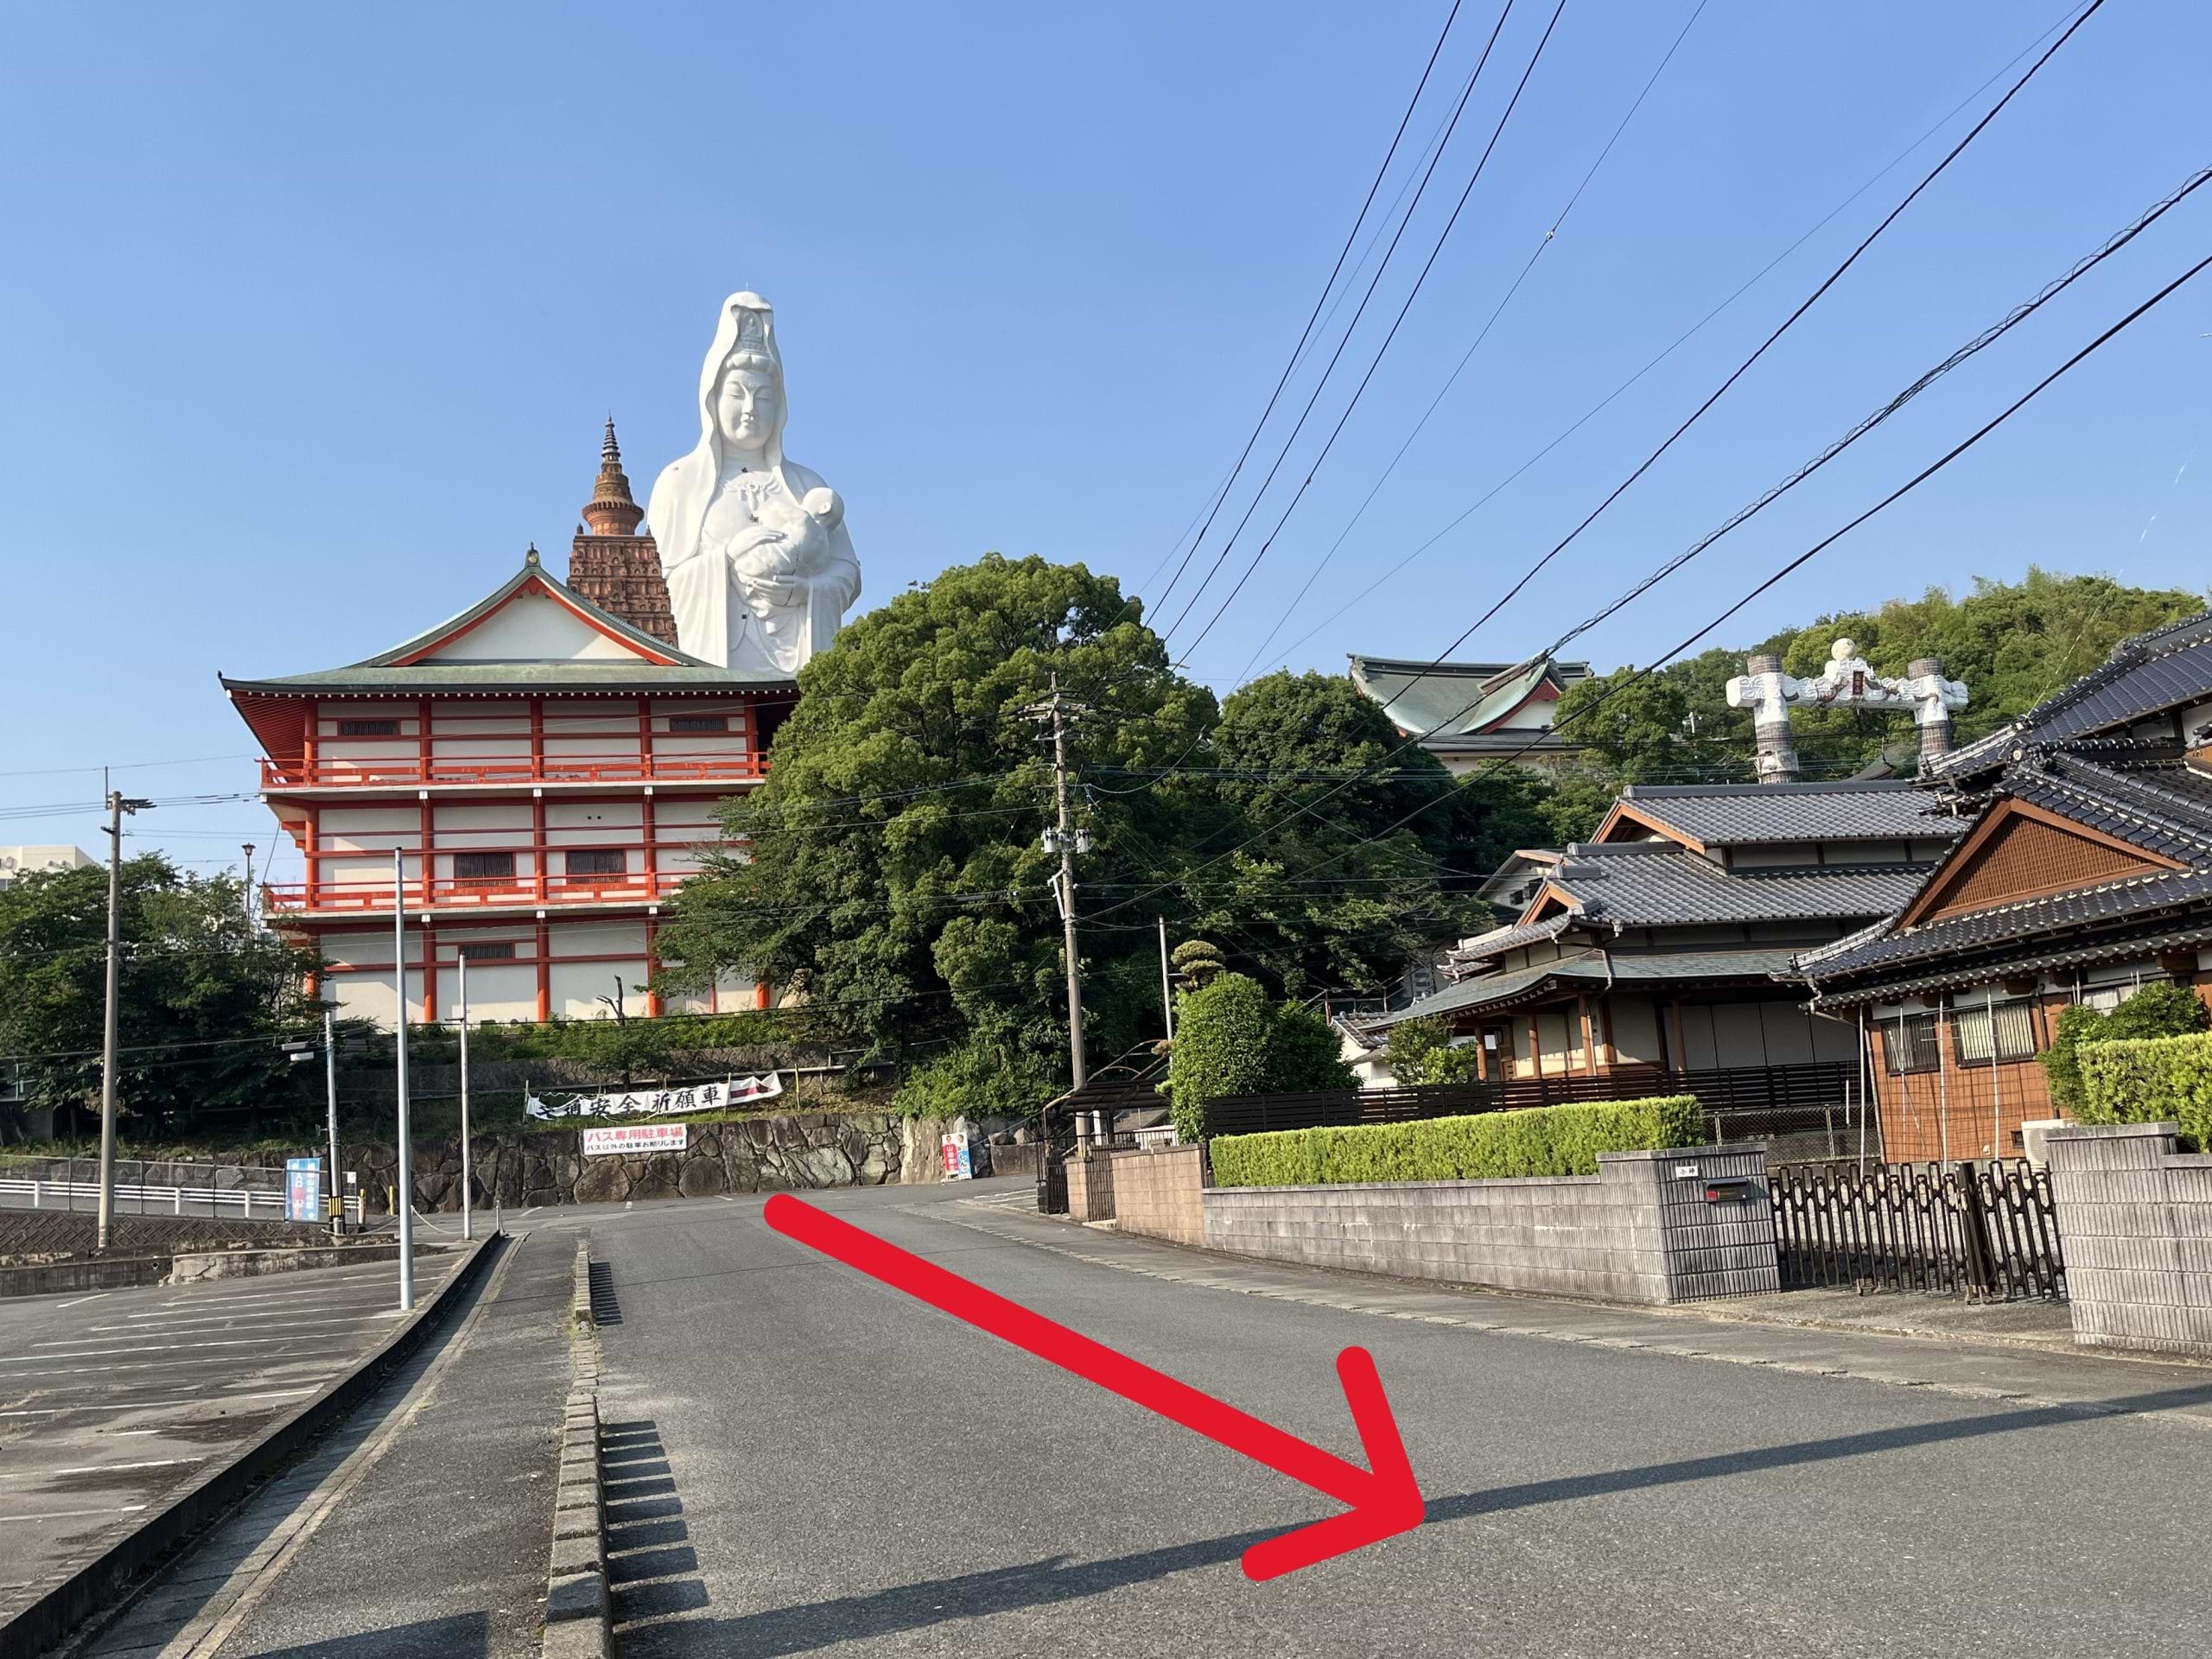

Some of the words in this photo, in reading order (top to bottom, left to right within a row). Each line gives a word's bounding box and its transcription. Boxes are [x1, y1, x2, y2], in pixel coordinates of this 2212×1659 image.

[588, 1127, 683, 1142] バス専用駐車場
[586, 1139, 684, 1151] バス以外の駐車お断りします
